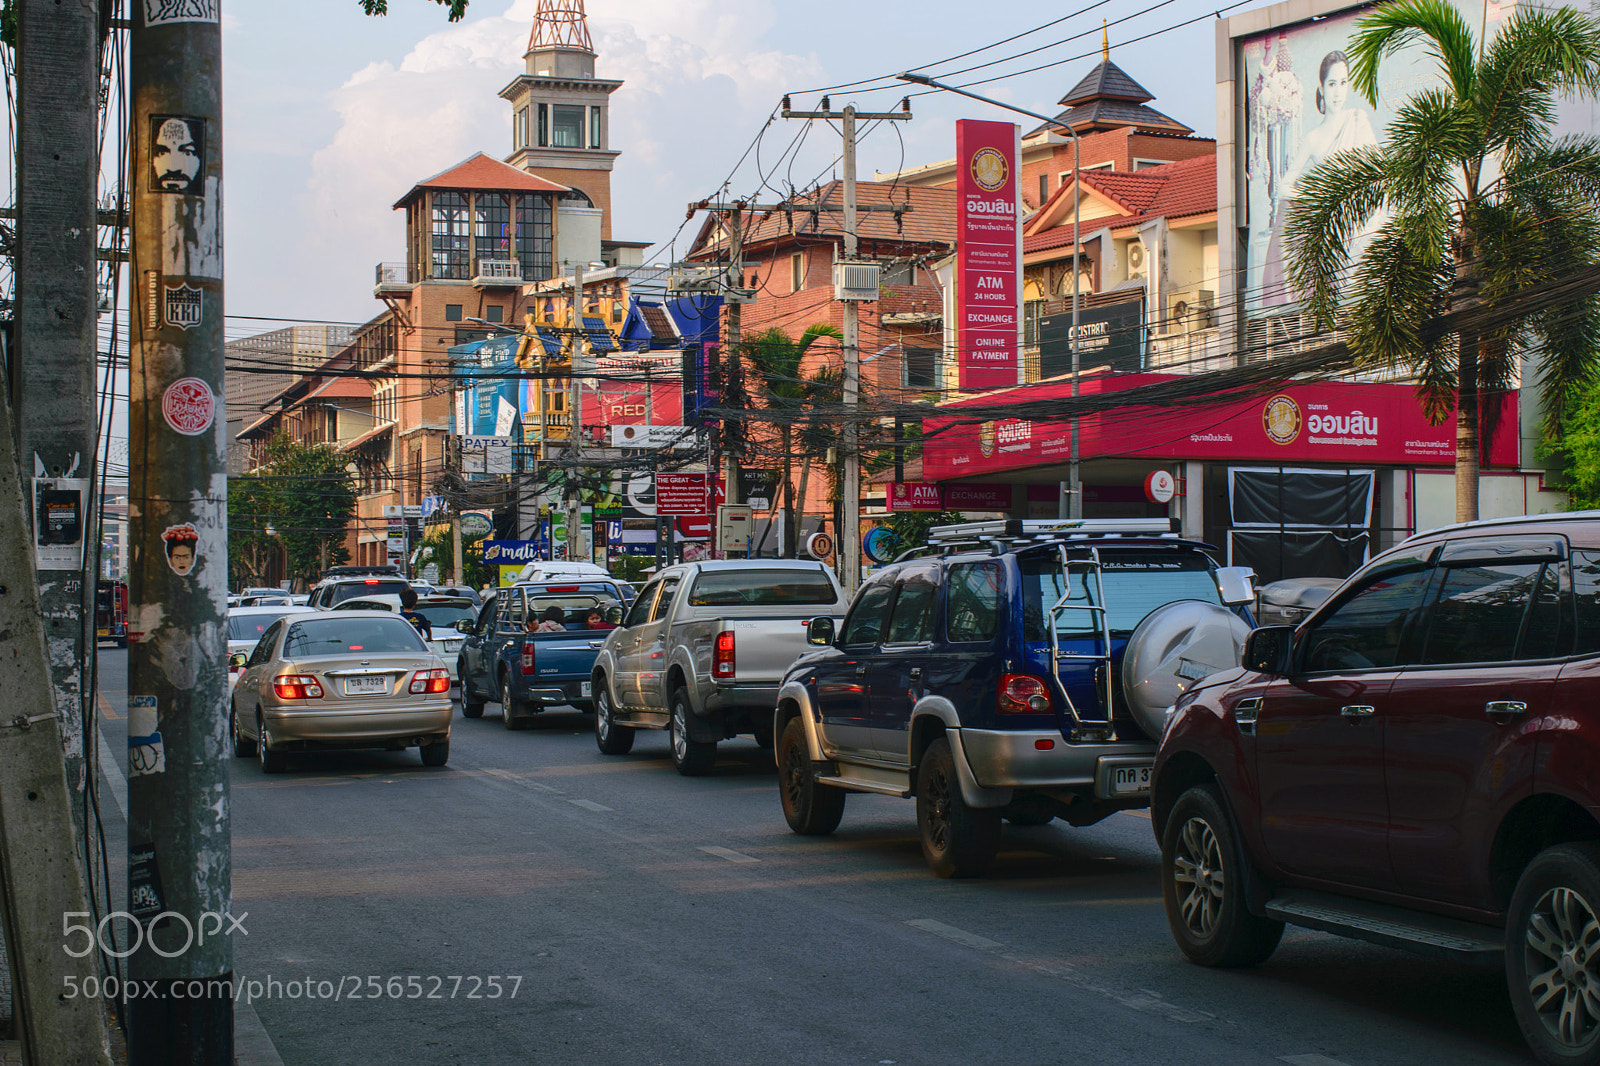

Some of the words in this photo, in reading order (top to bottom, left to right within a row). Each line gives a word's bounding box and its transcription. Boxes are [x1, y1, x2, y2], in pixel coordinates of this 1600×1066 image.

[967, 199, 1014, 214] ออมสิน
[977, 276, 1004, 289] ATM
[974, 292, 983, 300] 24
[984, 293, 1006, 301] HOURS
[967, 313, 1013, 324] EXCHANGE
[975, 338, 1006, 347] ONLINE
[972, 351, 1010, 361] PAYMENT
[611, 404, 646, 417] RED
[1308, 411, 1378, 435] ออมสิน
[914, 487, 938, 498] ATM
[951, 491, 997, 500] EXCHANGE
[608, 521, 622, 539] li
[502, 543, 537, 560] mali
[365, 677, 384, 686] 7329
[1117, 768, 1136, 783] กค
[1141, 768, 1153, 782] 3
